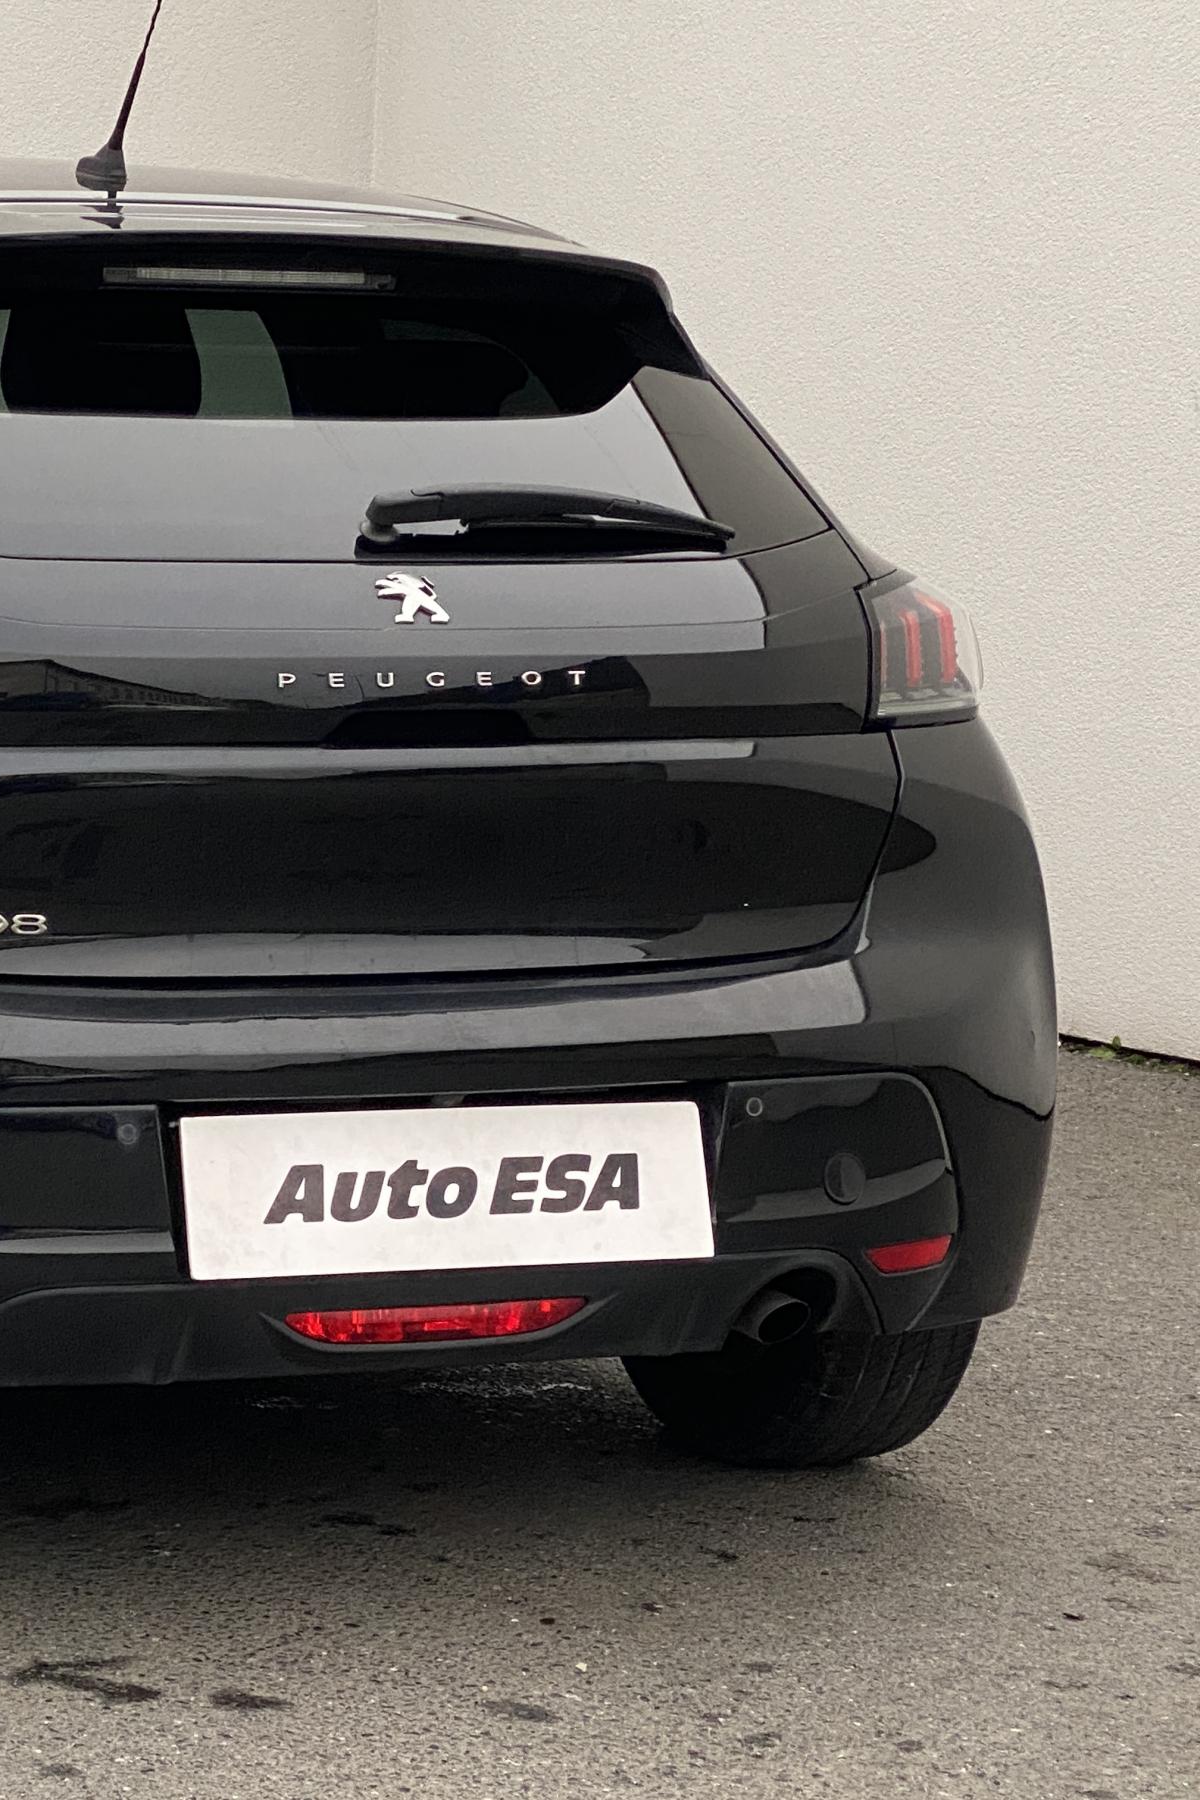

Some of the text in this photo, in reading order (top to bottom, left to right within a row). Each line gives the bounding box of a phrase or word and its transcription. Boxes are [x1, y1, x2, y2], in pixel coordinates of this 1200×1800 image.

[277, 670, 586, 689] PEUGEOT
[263, 1153, 640, 1225] Auto ESA
